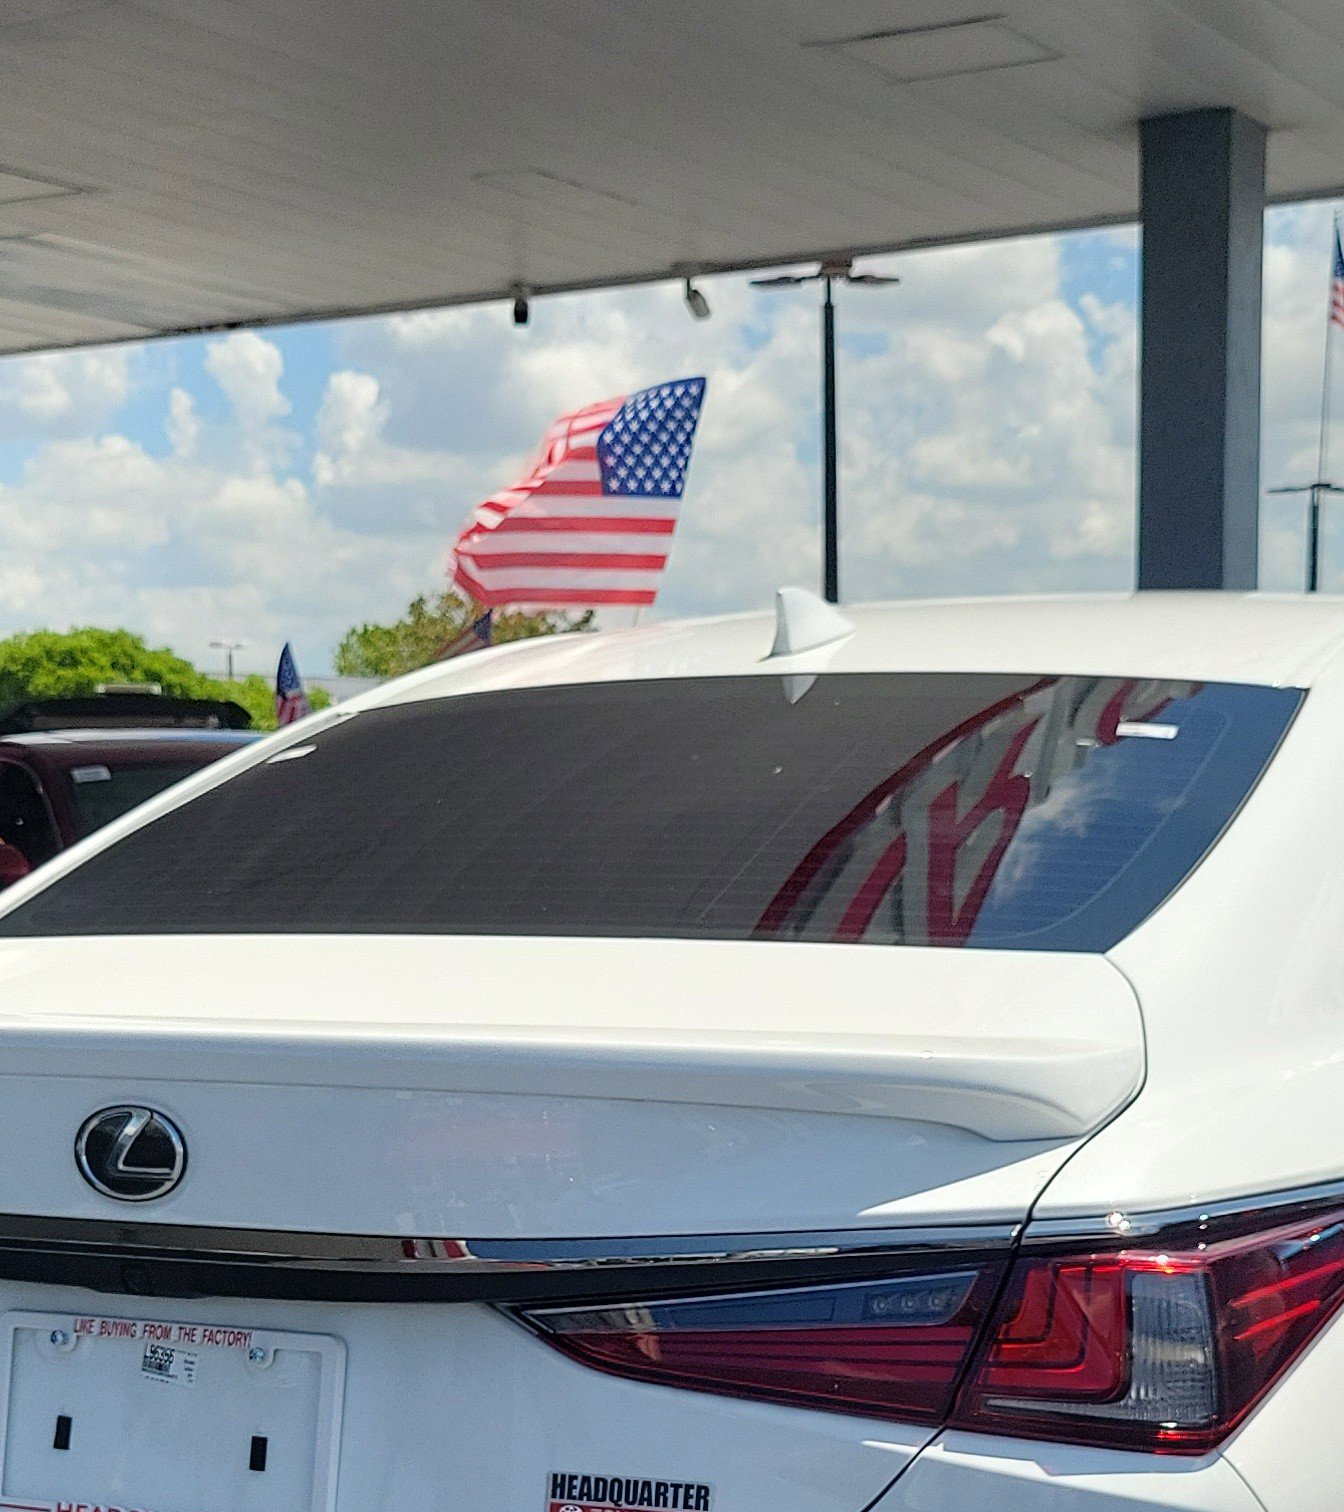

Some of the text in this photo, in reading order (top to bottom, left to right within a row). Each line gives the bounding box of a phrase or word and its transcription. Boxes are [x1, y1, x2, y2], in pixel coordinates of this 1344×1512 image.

[74, 1318, 252, 1347] LIKE BUYING FROM THE FACTORY!
[551, 1473, 711, 1512] HEADQUARTER
